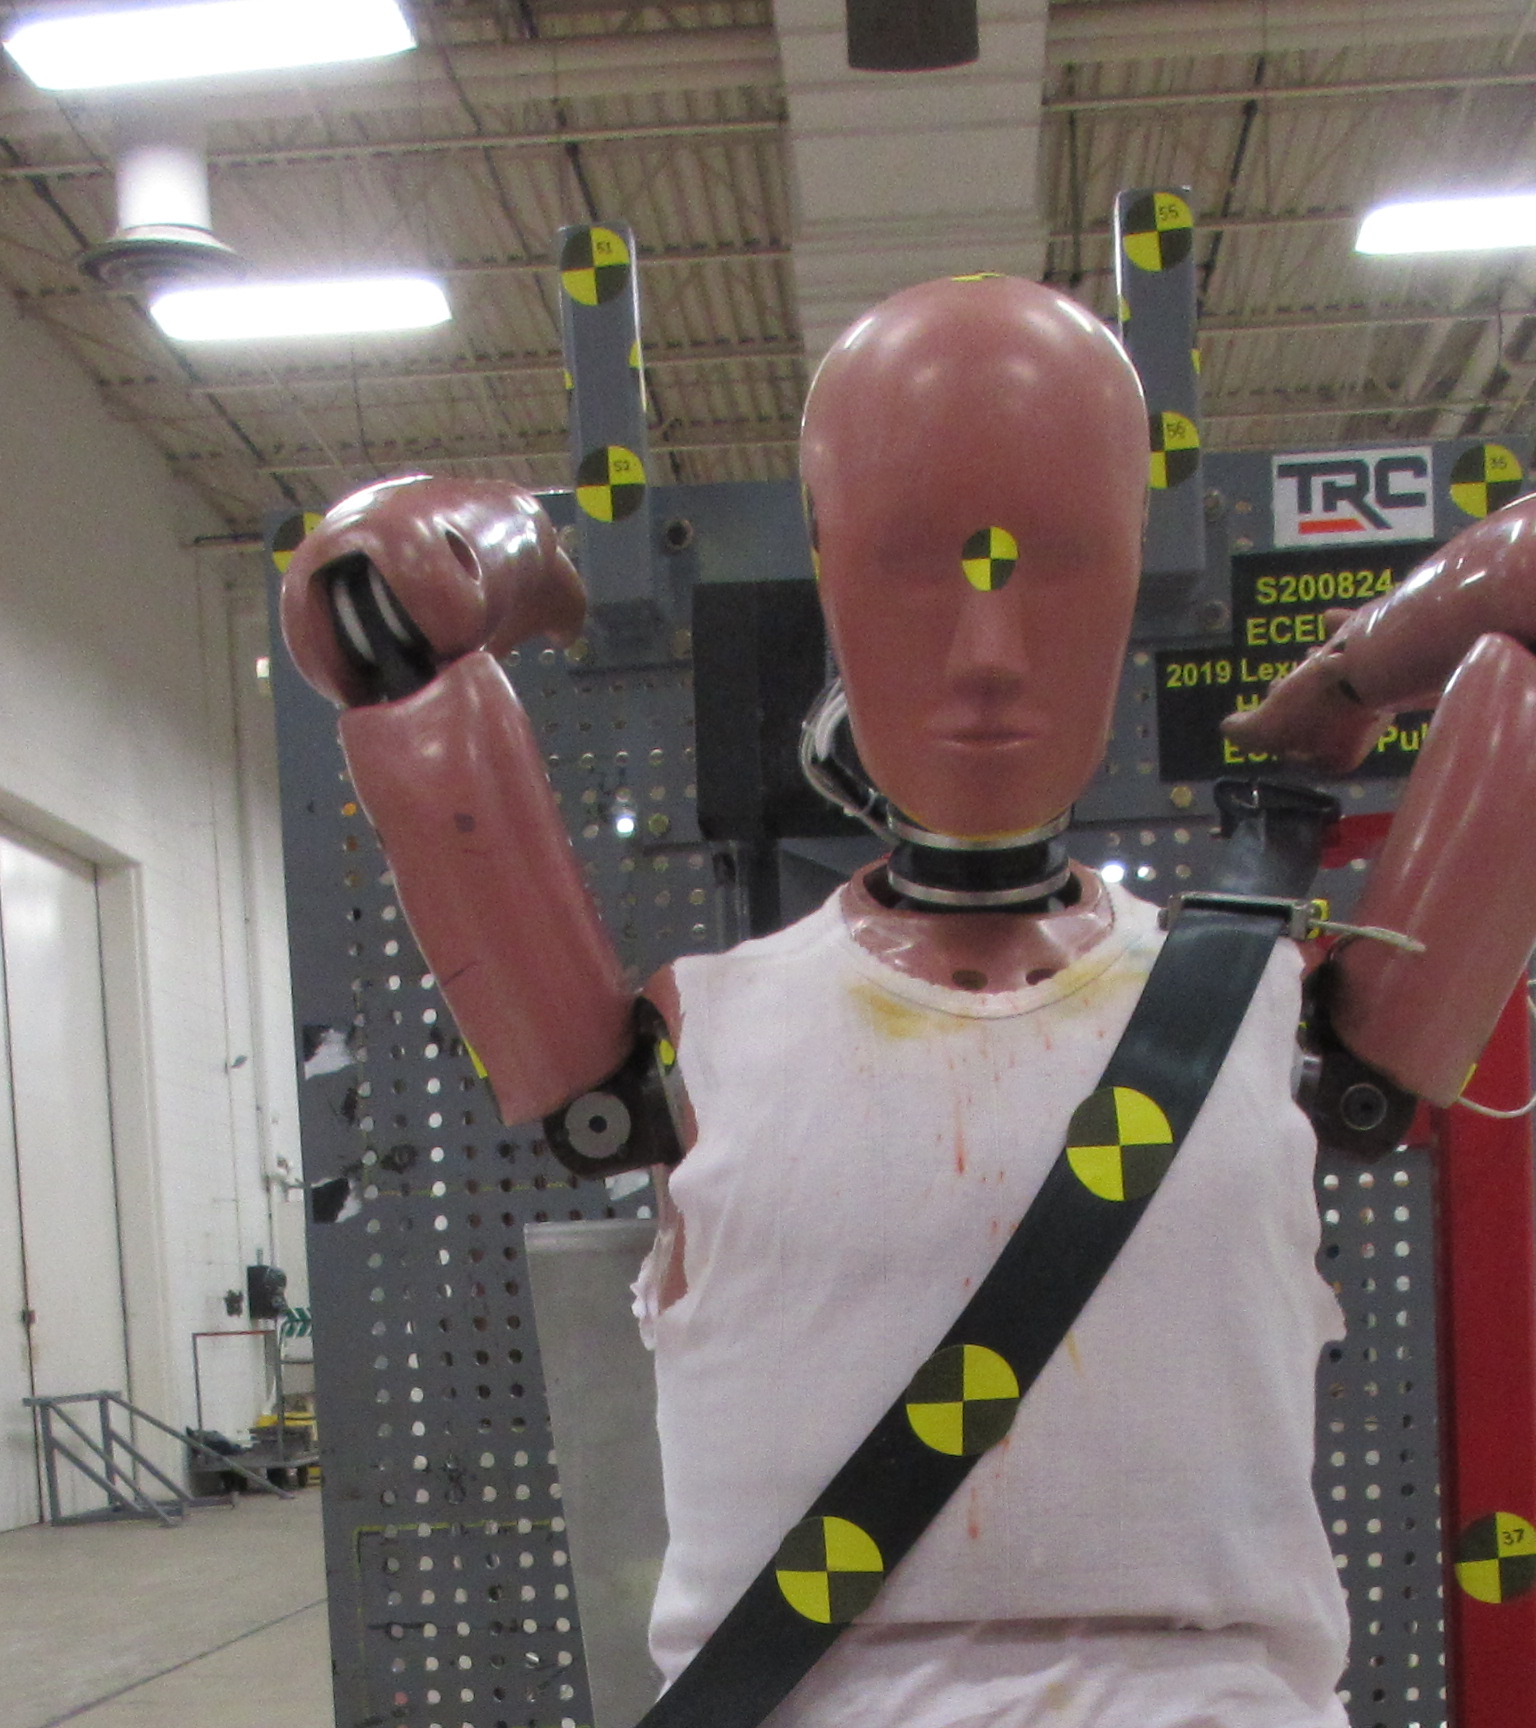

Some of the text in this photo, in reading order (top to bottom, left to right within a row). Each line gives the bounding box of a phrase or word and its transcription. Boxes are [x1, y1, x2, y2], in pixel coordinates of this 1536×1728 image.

[1278, 456, 1427, 530] TRC
[1166, 660, 1233, 688] 2019
[1503, 1528, 1524, 1546] 37
